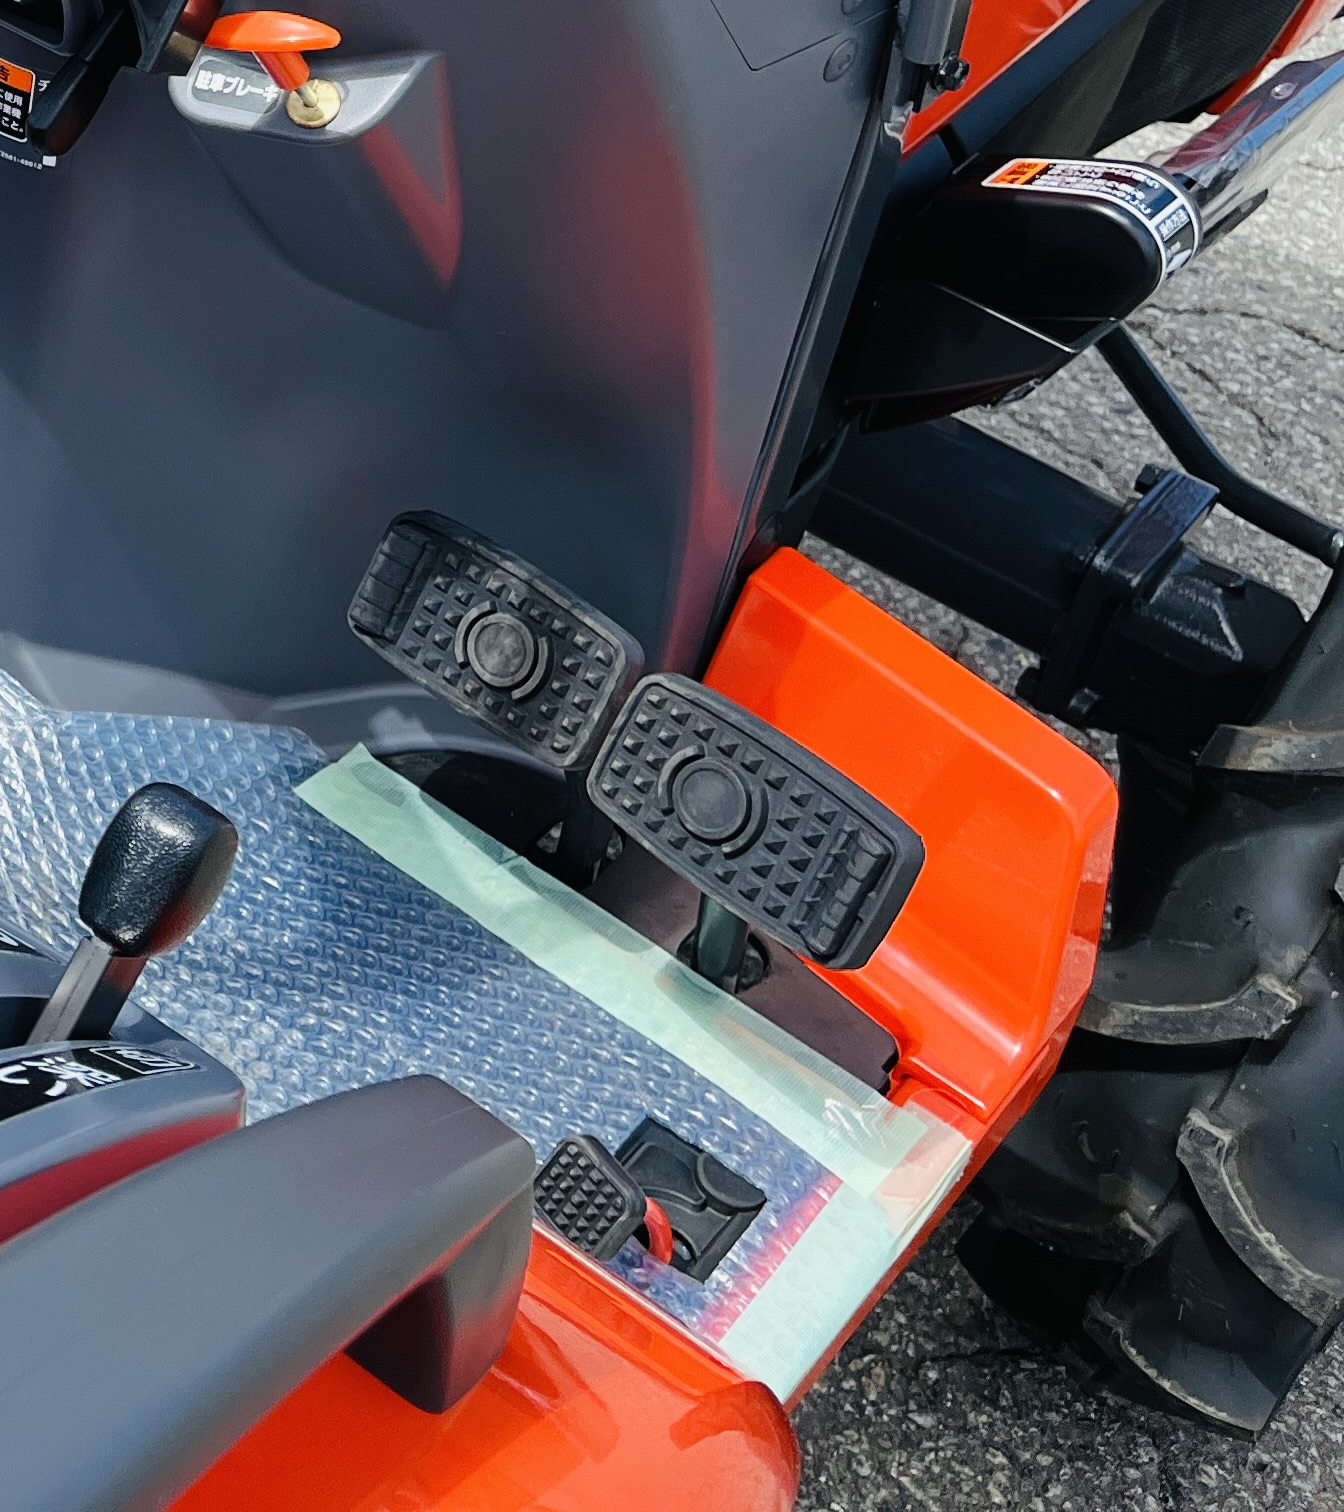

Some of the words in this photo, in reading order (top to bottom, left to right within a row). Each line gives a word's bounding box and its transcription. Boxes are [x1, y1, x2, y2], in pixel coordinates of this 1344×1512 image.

[194, 70, 280, 103] 駐車ブレーキ
